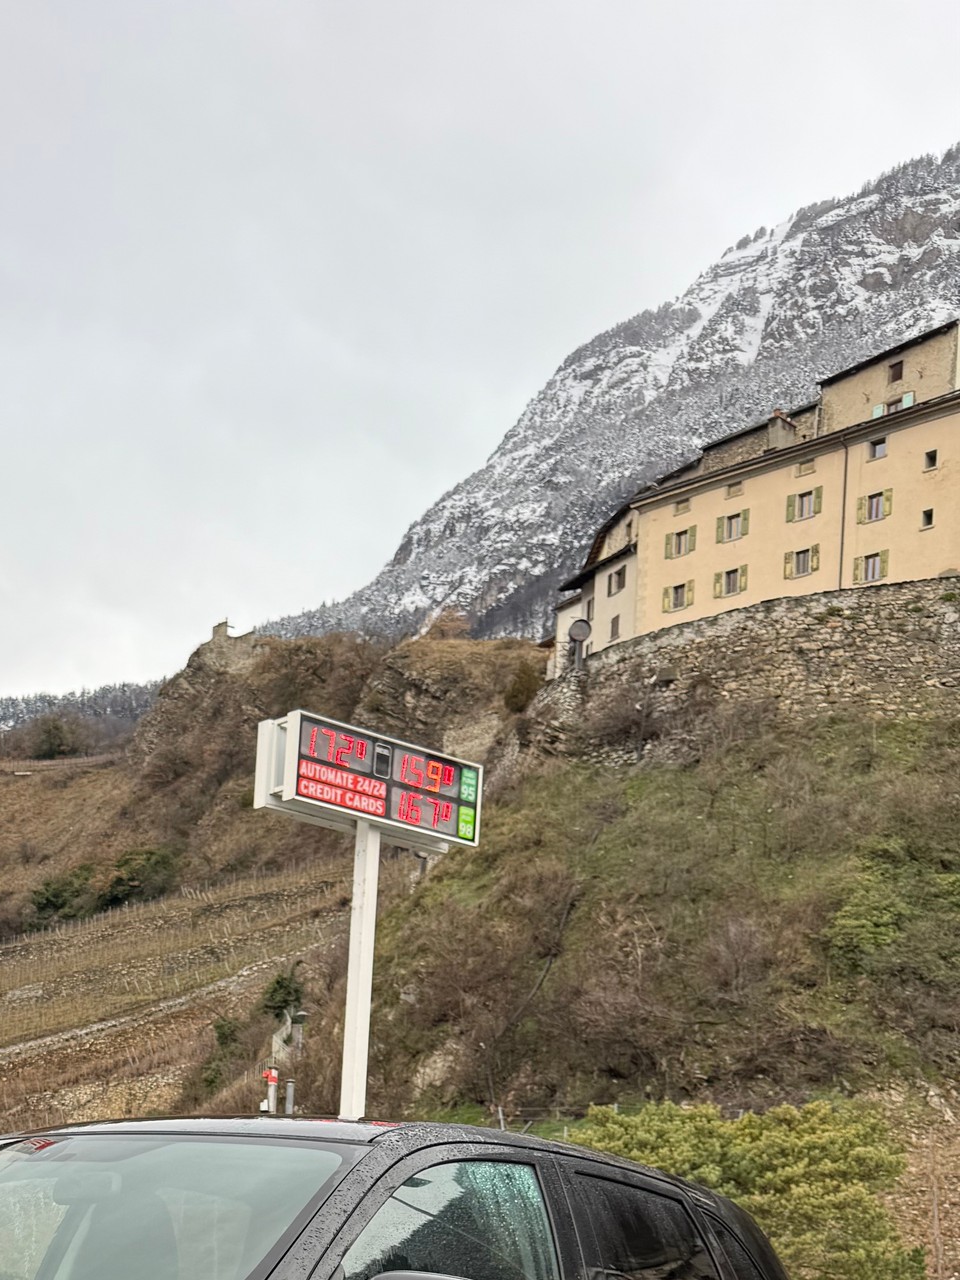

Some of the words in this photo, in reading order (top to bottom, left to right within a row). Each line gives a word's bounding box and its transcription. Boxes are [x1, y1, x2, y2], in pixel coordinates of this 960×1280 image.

[300, 762, 355, 789] AUTOMATE
[356, 777, 386, 798] 24/24
[300, 781, 343, 803] CREDIT
[345, 792, 383, 814] CARDS
[461, 785, 475, 801] 95
[459, 822, 473, 837] 98
